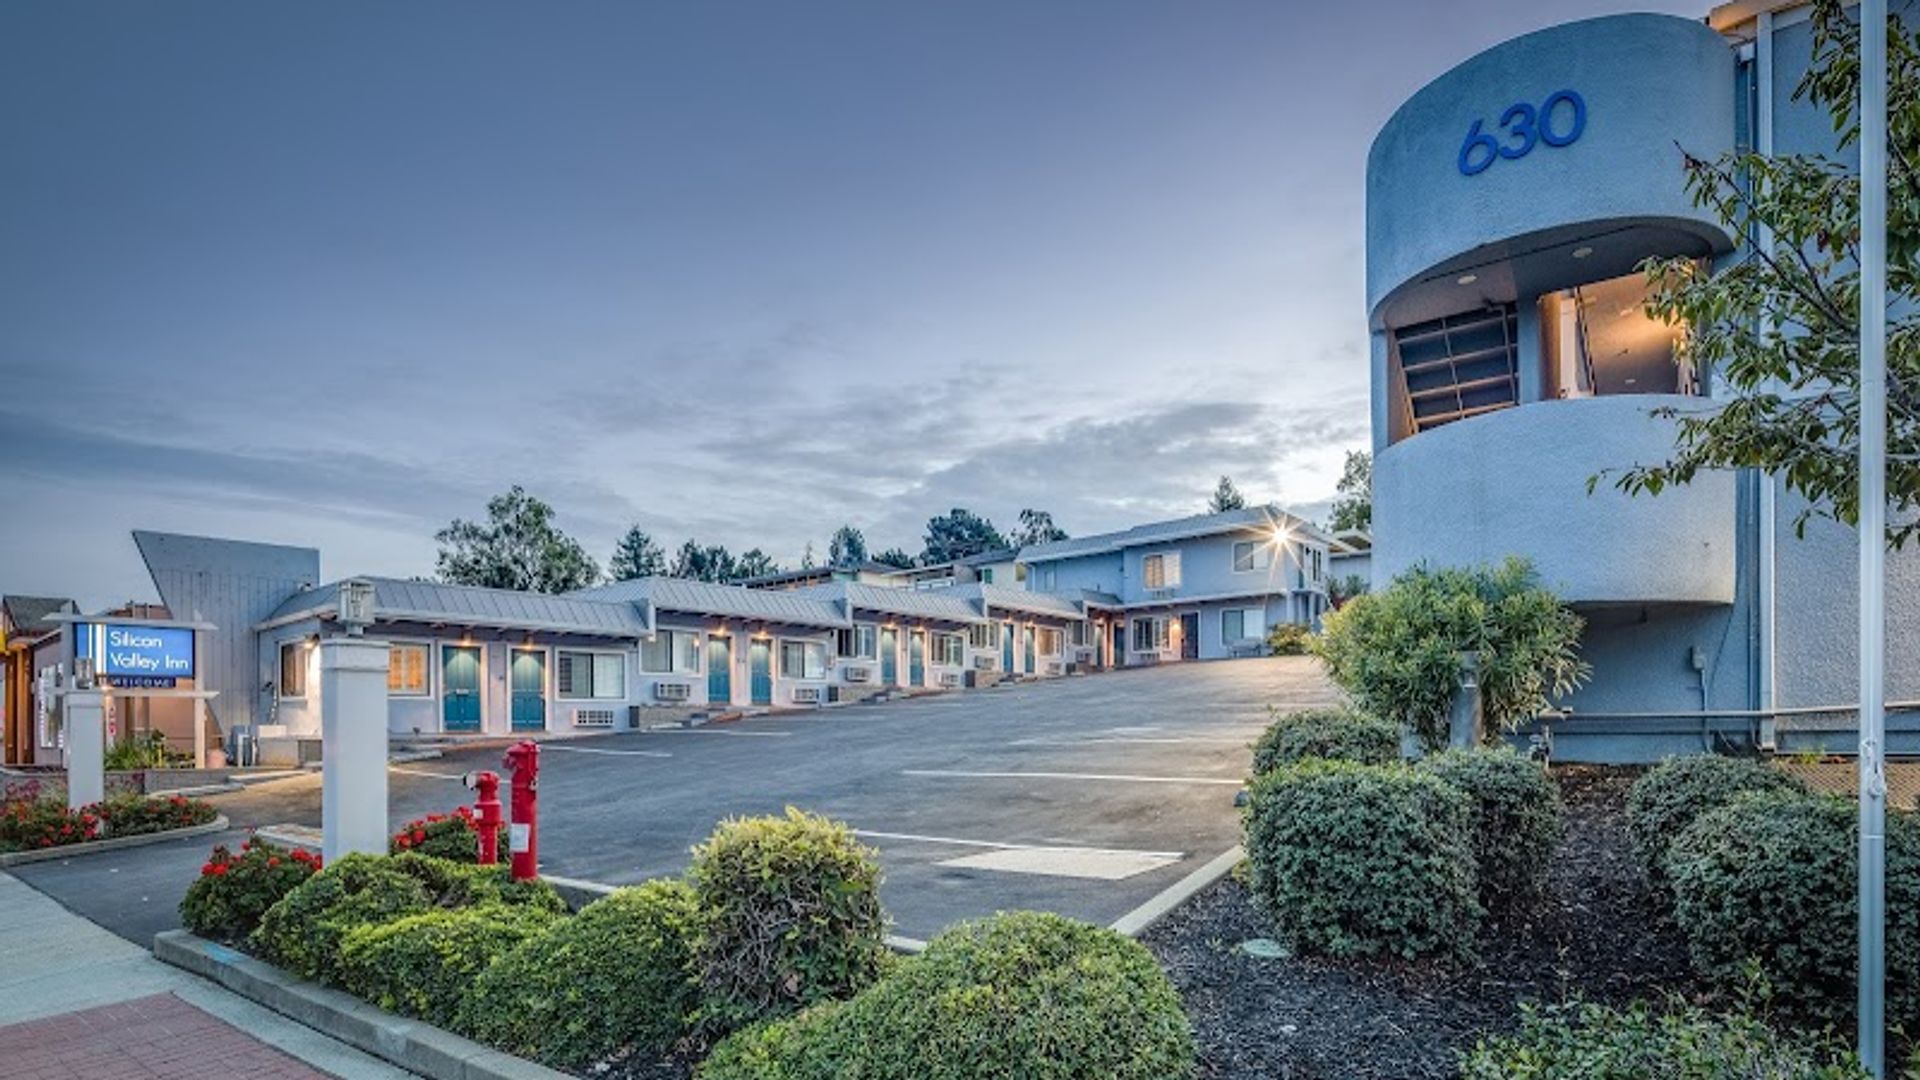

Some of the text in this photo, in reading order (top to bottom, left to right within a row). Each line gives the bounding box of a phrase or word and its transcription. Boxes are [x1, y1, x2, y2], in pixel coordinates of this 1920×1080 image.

[1457, 88, 1588, 177] 630
[109, 630, 163, 648] Silicon
[109, 652, 189, 672] Valley Inn
[111, 677, 171, 688] WELCOME
